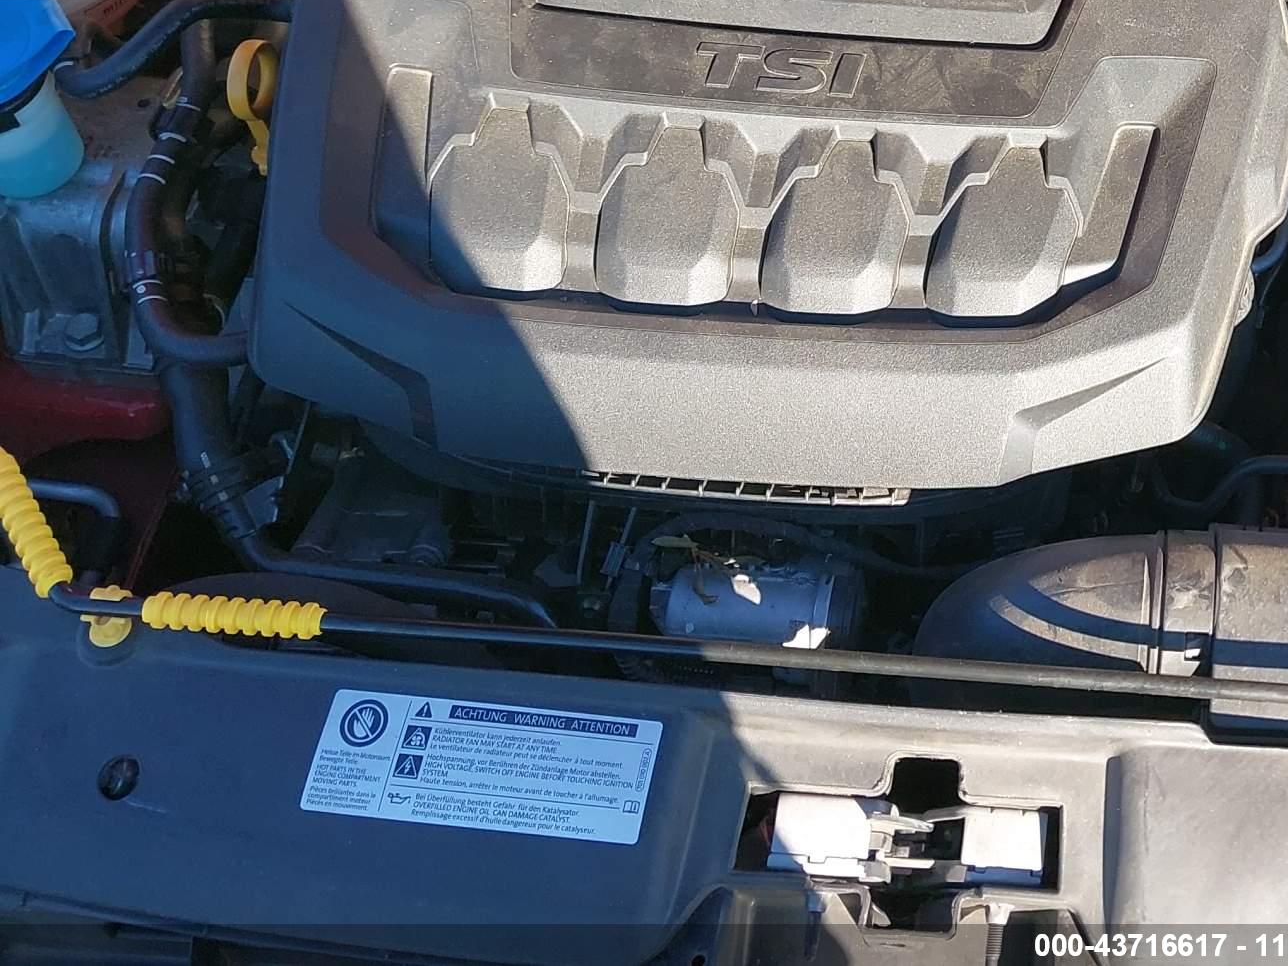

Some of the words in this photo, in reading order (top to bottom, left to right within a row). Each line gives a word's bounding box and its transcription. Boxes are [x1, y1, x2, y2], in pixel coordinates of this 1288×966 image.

[696, 41, 868, 98] TSI
[454, 707, 508, 722] ACHTUNG
[513, 713, 566, 729] WARNING
[570, 719, 630, 735] ATTENTION
[432, 735, 465, 744] RADIATOR
[496, 741, 516, 749] START
[439, 744, 473, 753] ventilateur
[483, 748, 513, 757] radiateur
[314, 769, 337, 779] ENGINE
[337, 772, 381, 783] COMPARTMENT
[329, 765, 347, 773] PARTS
[424, 761, 443, 770] HIGH
[475, 766, 501, 775] SWITCH
[515, 770, 540, 779] ENGINE
[540, 772, 565, 782] BEFORE
[565, 775, 602, 786] TOUCHING
[602, 778, 634, 790] IGNITION
[569, 768, 589, 776] Motor
[313, 777, 338, 786] MOVING
[420, 776, 440, 785] Haute
[499, 784, 525, 794] moteur
[553, 790, 578, 799] toucher
[413, 801, 452, 812] OVERFILLED
[452, 804, 478, 814] ENGINE
[508, 811, 539, 821] DAMAGE
[466, 798, 492, 807] besteht
[492, 801, 515, 810] Gefahr
[411, 809, 452, 821] Remplissage
